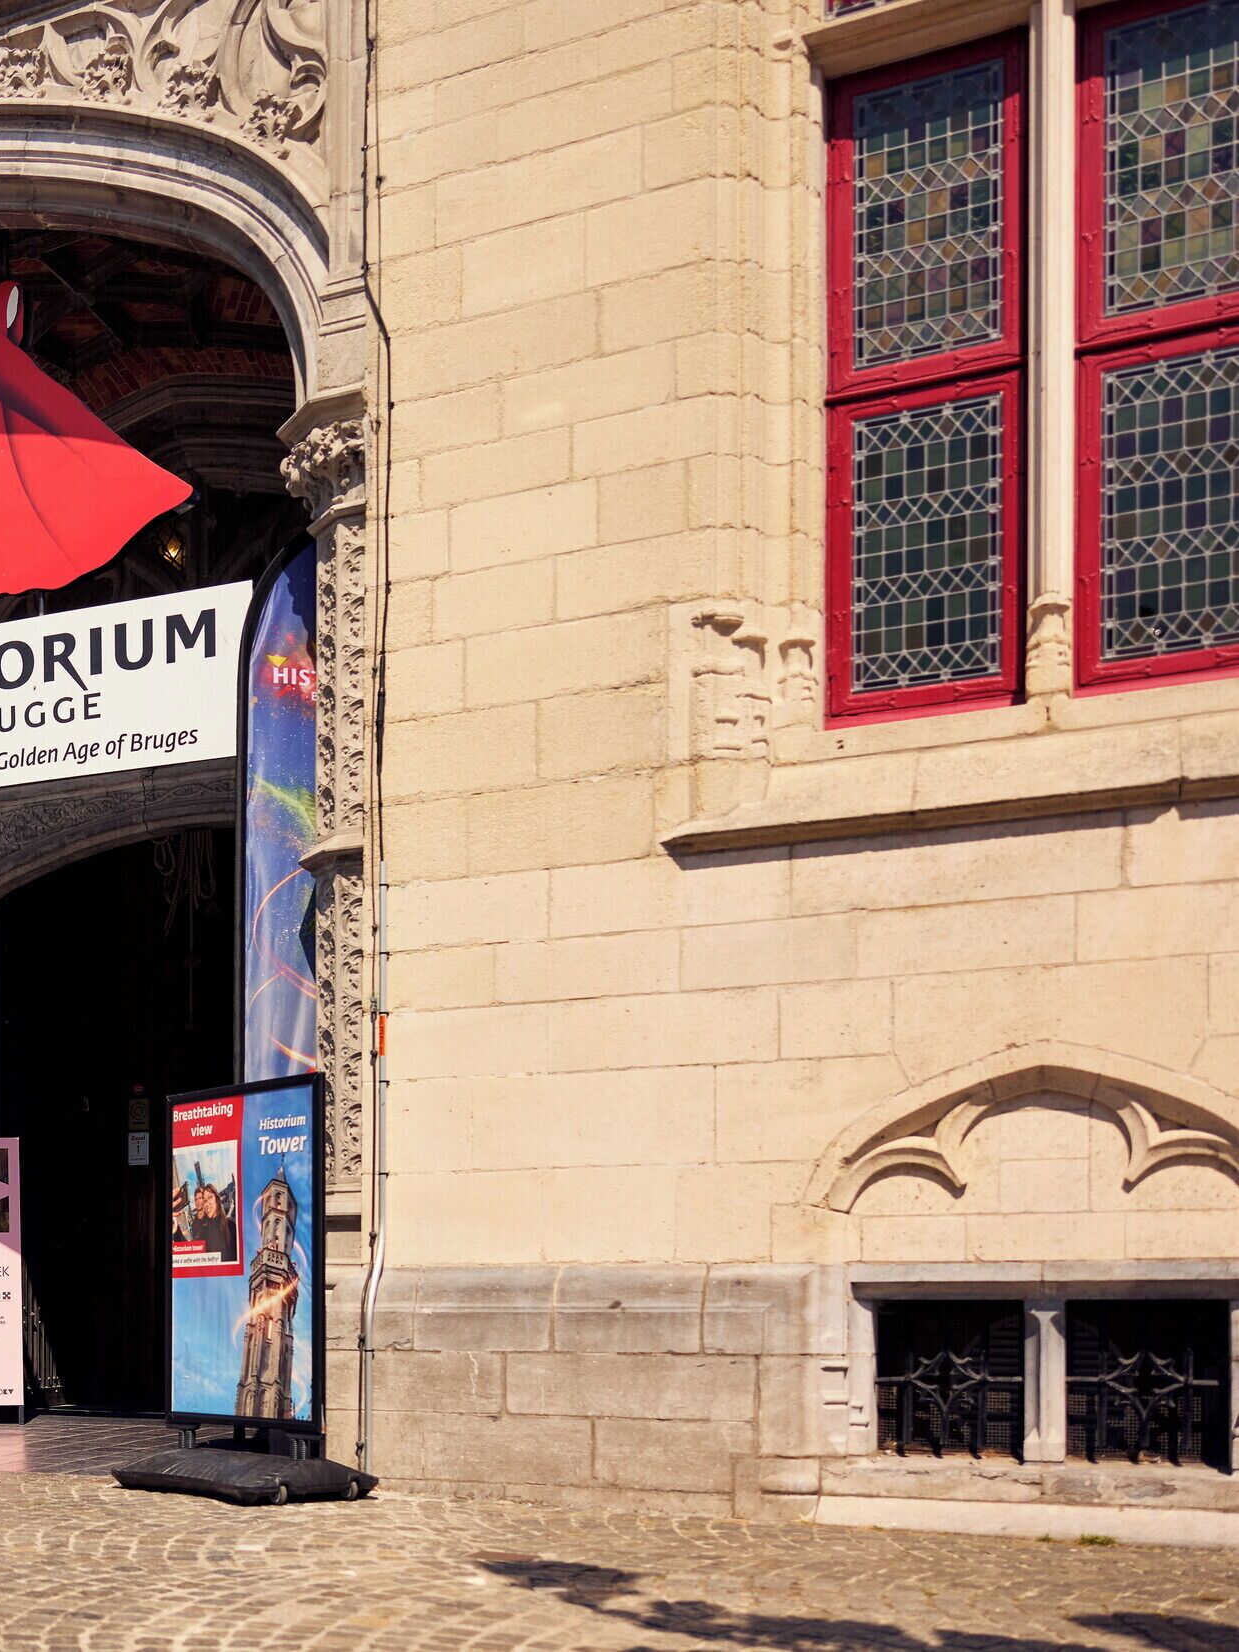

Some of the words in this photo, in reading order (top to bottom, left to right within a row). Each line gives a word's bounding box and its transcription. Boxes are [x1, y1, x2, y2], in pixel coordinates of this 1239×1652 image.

[272, 666, 316, 687] HIS
[63, 741, 100, 766] Age
[105, 732, 128, 758] of
[131, 729, 199, 754] Bruges
[173, 1102, 233, 1123] Breathtaking
[259, 1114, 306, 1131] Historium
[191, 1124, 213, 1137] view
[258, 1135, 308, 1155] Tower
